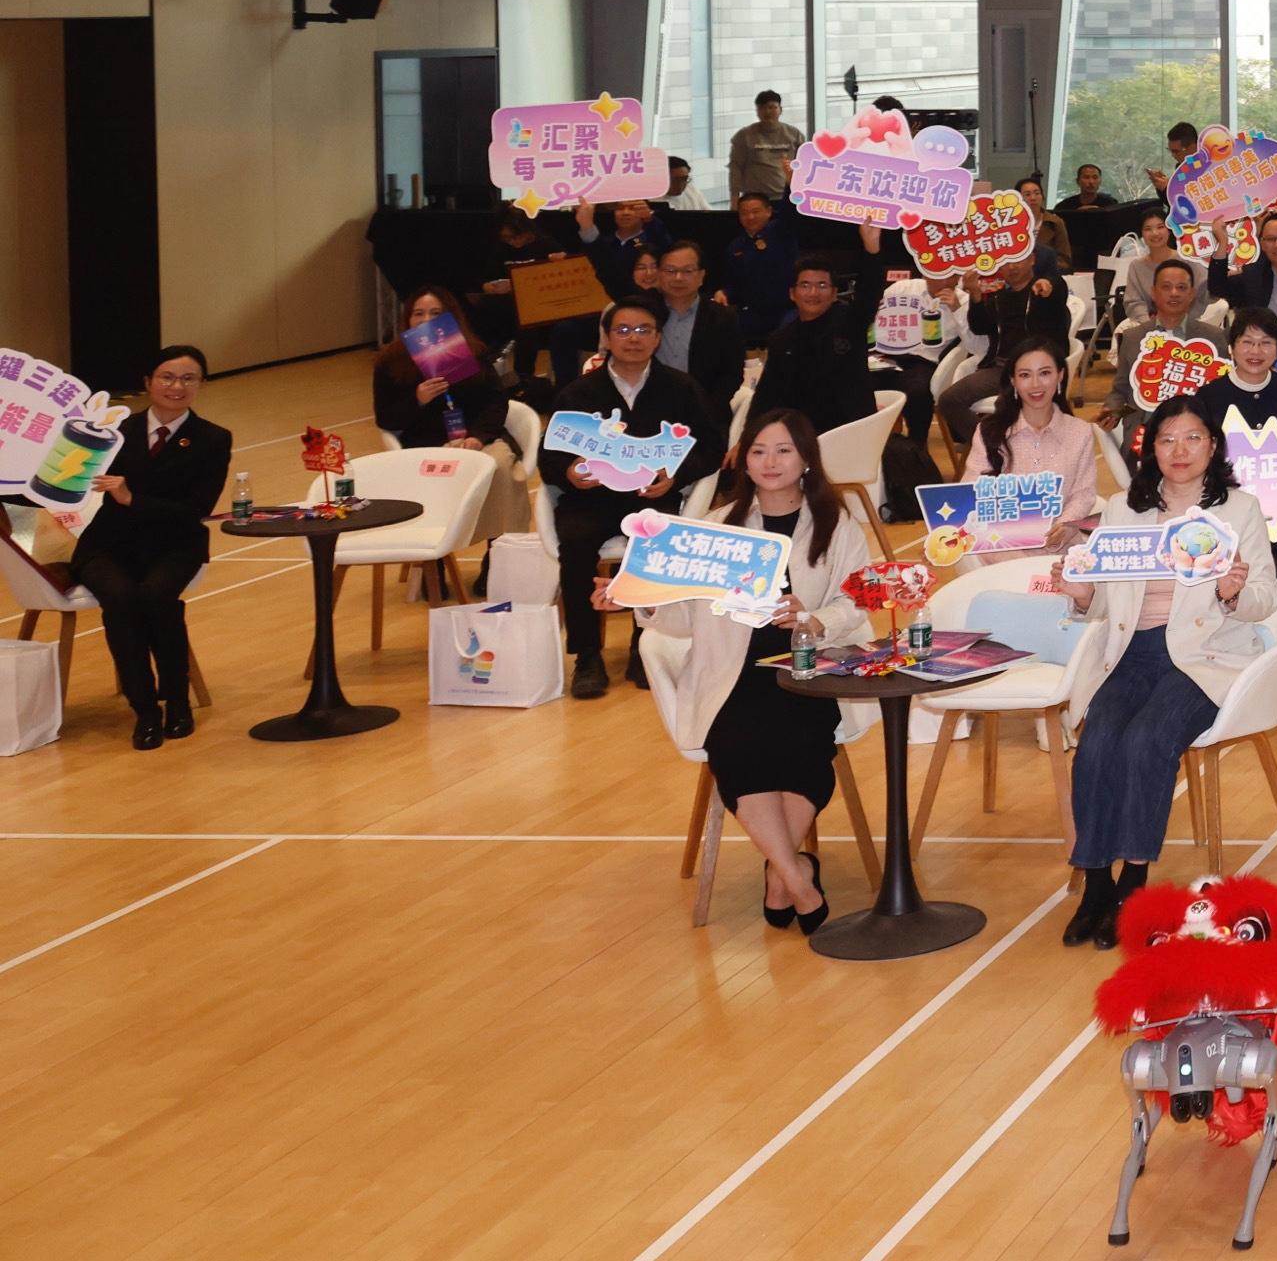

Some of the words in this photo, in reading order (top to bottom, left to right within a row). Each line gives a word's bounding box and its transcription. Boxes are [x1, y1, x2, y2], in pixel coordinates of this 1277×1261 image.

[541, 124, 600, 152] 汇聚
[513, 150, 645, 181] 每一束V光
[804, 158, 961, 210] 广东欢迎你
[810, 197, 888, 221] WELCOME
[937, 231, 1014, 262] 有钱有闲
[1173, 348, 1211, 365] 2026
[1162, 359, 1207, 388] 福马
[0, 395, 56, 445] 能量
[552, 424, 612, 457] 流量向上
[975, 475, 1057, 500] 你的V光
[975, 496, 1063, 522] 照亮一方
[669, 530, 753, 565] 心有所悦
[1097, 536, 1153, 553] 共创共享
[642, 550, 730, 585] 业有所长
[1100, 554, 1157, 572] 美好生活
[1206, 1043, 1218, 1058] 02
